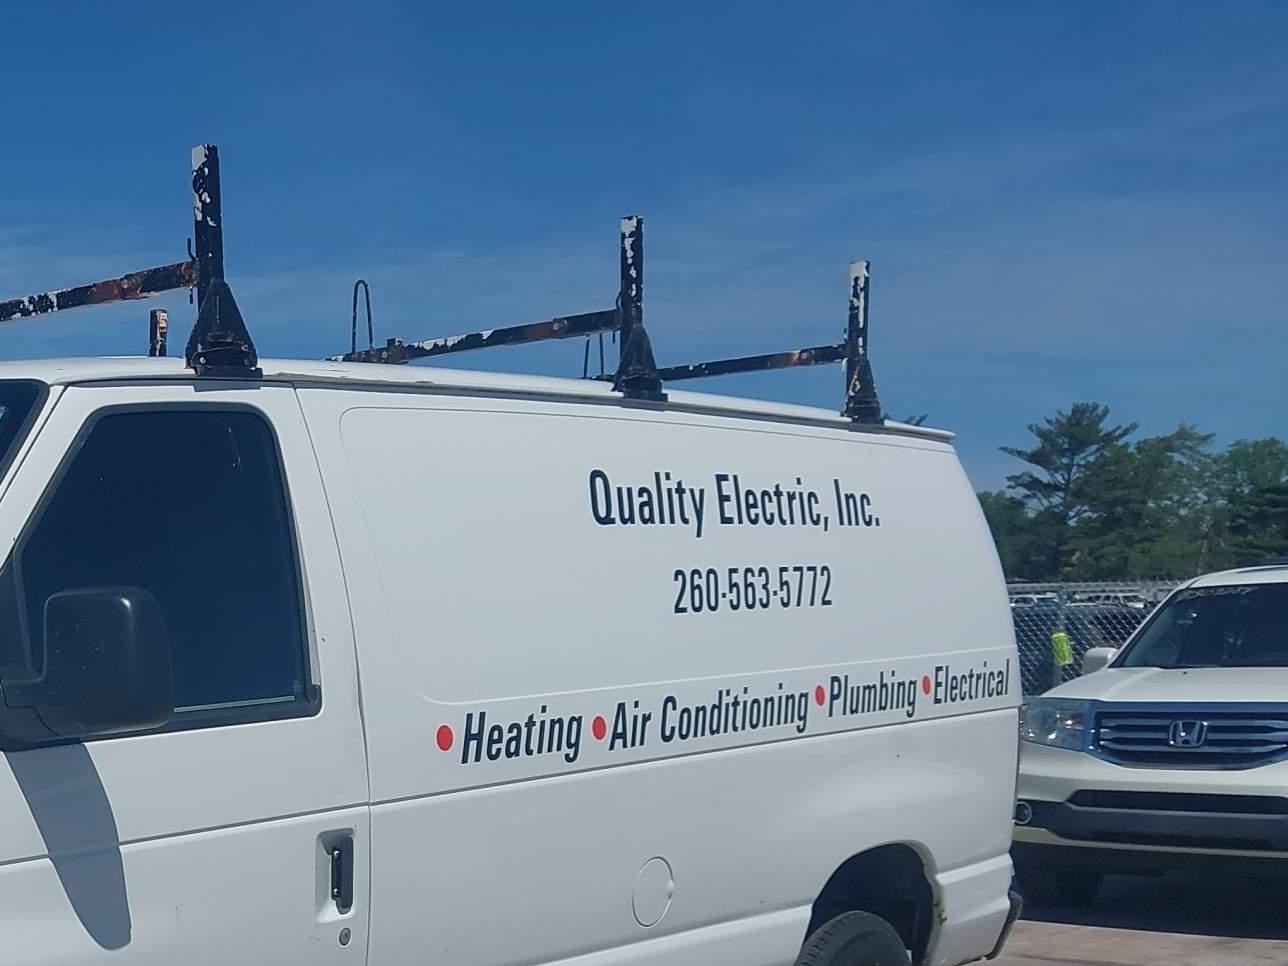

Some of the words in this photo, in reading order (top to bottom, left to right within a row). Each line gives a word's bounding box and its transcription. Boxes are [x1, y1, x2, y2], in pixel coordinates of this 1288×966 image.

[589, 469, 705, 538] Quality
[715, 473, 829, 532] Electric,
[833, 478, 880, 527] Inc.
[673, 565, 833, 614] 260-563-5772
[461, 704, 583, 763] Heating
[609, 700, 652, 751] Air
[660, 682, 810, 743] Conditioning
[828, 670, 918, 718] Plumbing
[933, 658, 1010, 705] Electrical
